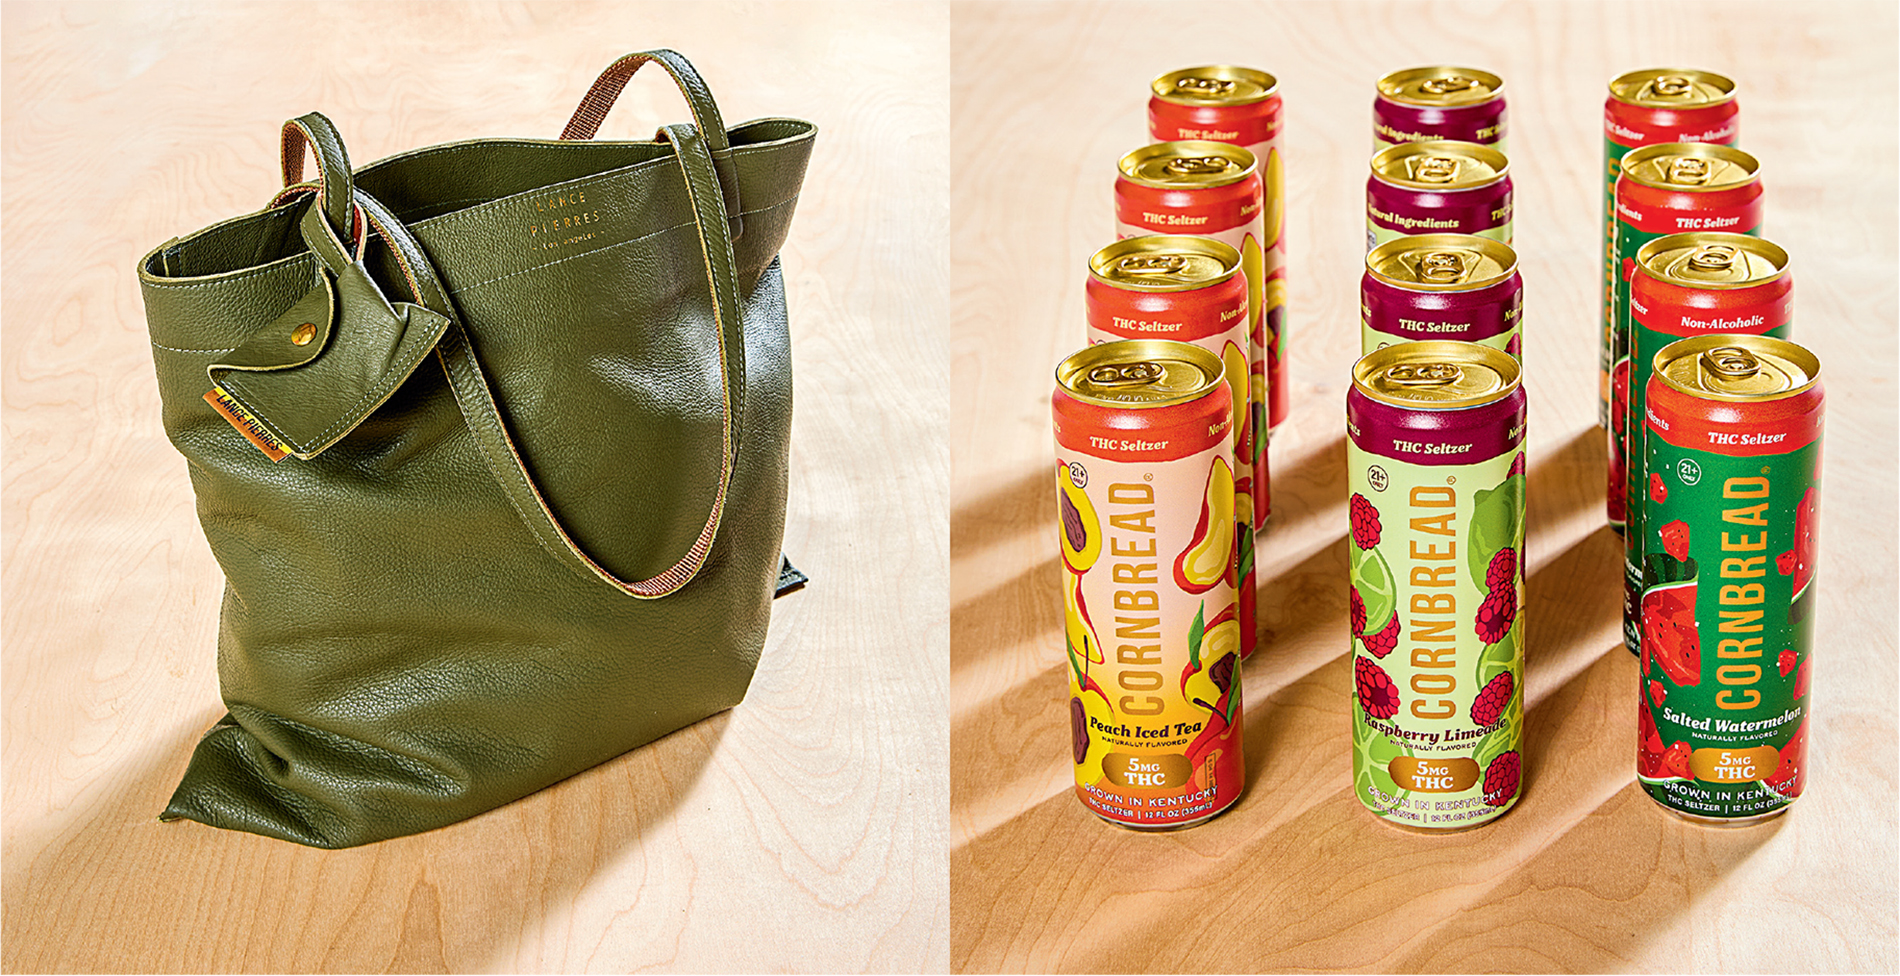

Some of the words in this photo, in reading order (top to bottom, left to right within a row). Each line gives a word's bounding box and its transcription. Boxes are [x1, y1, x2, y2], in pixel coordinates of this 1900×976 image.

[1178, 128, 1200, 139] THC
[1202, 130, 1239, 140] Seltzer
[536, 191, 586, 212] LANCE
[530, 210, 599, 237] PIERRES
[1143, 212, 1166, 224] THC
[1167, 215, 1208, 225] Seltzer
[1395, 214, 1459, 229] Ingredients
[1676, 217, 1701, 228] THC
[1703, 216, 1740, 228] Seltzer
[1113, 317, 1136, 331] THC
[1138, 320, 1183, 332] Seltzer
[1399, 318, 1425, 331] THC
[1426, 322, 1470, 333] Seltzer
[1681, 315, 1764, 329] Non-Alcoholic
[216, 394, 249, 422] LANCE
[243, 417, 283, 451] PIERRES
[1089, 436, 1118, 450] THC
[1120, 439, 1169, 451] Seltzer
[1708, 431, 1739, 445] THC
[1740, 432, 1787, 446] Seltzer
[1393, 439, 1422, 453] THC
[1424, 443, 1473, 455] Seltzer
[1071, 465, 1084, 478] 21+
[1371, 469, 1385, 481] 21+
[1681, 463, 1698, 474] 21+
[1663, 707, 1711, 731] Salted
[1715, 706, 1802, 733] Watermelon
[1090, 716, 1131, 738] Peach
[1135, 725, 1169, 739] Iced
[1174, 721, 1202, 736] Tea
[1364, 712, 1440, 745] Raspberry
[1443, 717, 1507, 742] Limeade
[1102, 736, 1143, 748] NATURALLY
[1146, 738, 1188, 748] FLAVORED
[1692, 731, 1737, 742] NATURALLY
[1739, 729, 1778, 741] FLAVORED
[1390, 739, 1433, 751] NATURALLY
[1436, 741, 1477, 751] FLAVORED
[1128, 758, 1160, 771] 5MG
[1719, 752, 1751, 765] 5MG
[1416, 761, 1449, 775] 5MG
[1714, 766, 1756, 779] THC
[1124, 772, 1166, 786] THC
[1411, 775, 1454, 789] THC
[1085, 782, 1123, 804] GROWN
[1129, 797, 1142, 807] IN
[1149, 784, 1218, 807] KENTUCKY
[1663, 779, 1711, 800] GROWN
[1716, 791, 1731, 801] IN
[1737, 774, 1798, 801] KENTUCKY
[1367, 785, 1410, 808] GROWN
[1415, 801, 1429, 810] IN
[1435, 788, 1503, 811] KENTUCKY
[1667, 794, 1683, 806] THC
[1684, 800, 1720, 811] SELTZER
[1754, 800, 1765, 810] OZ
[1102, 803, 1134, 817] SELTZER
[1168, 809, 1179, 817] OZ
